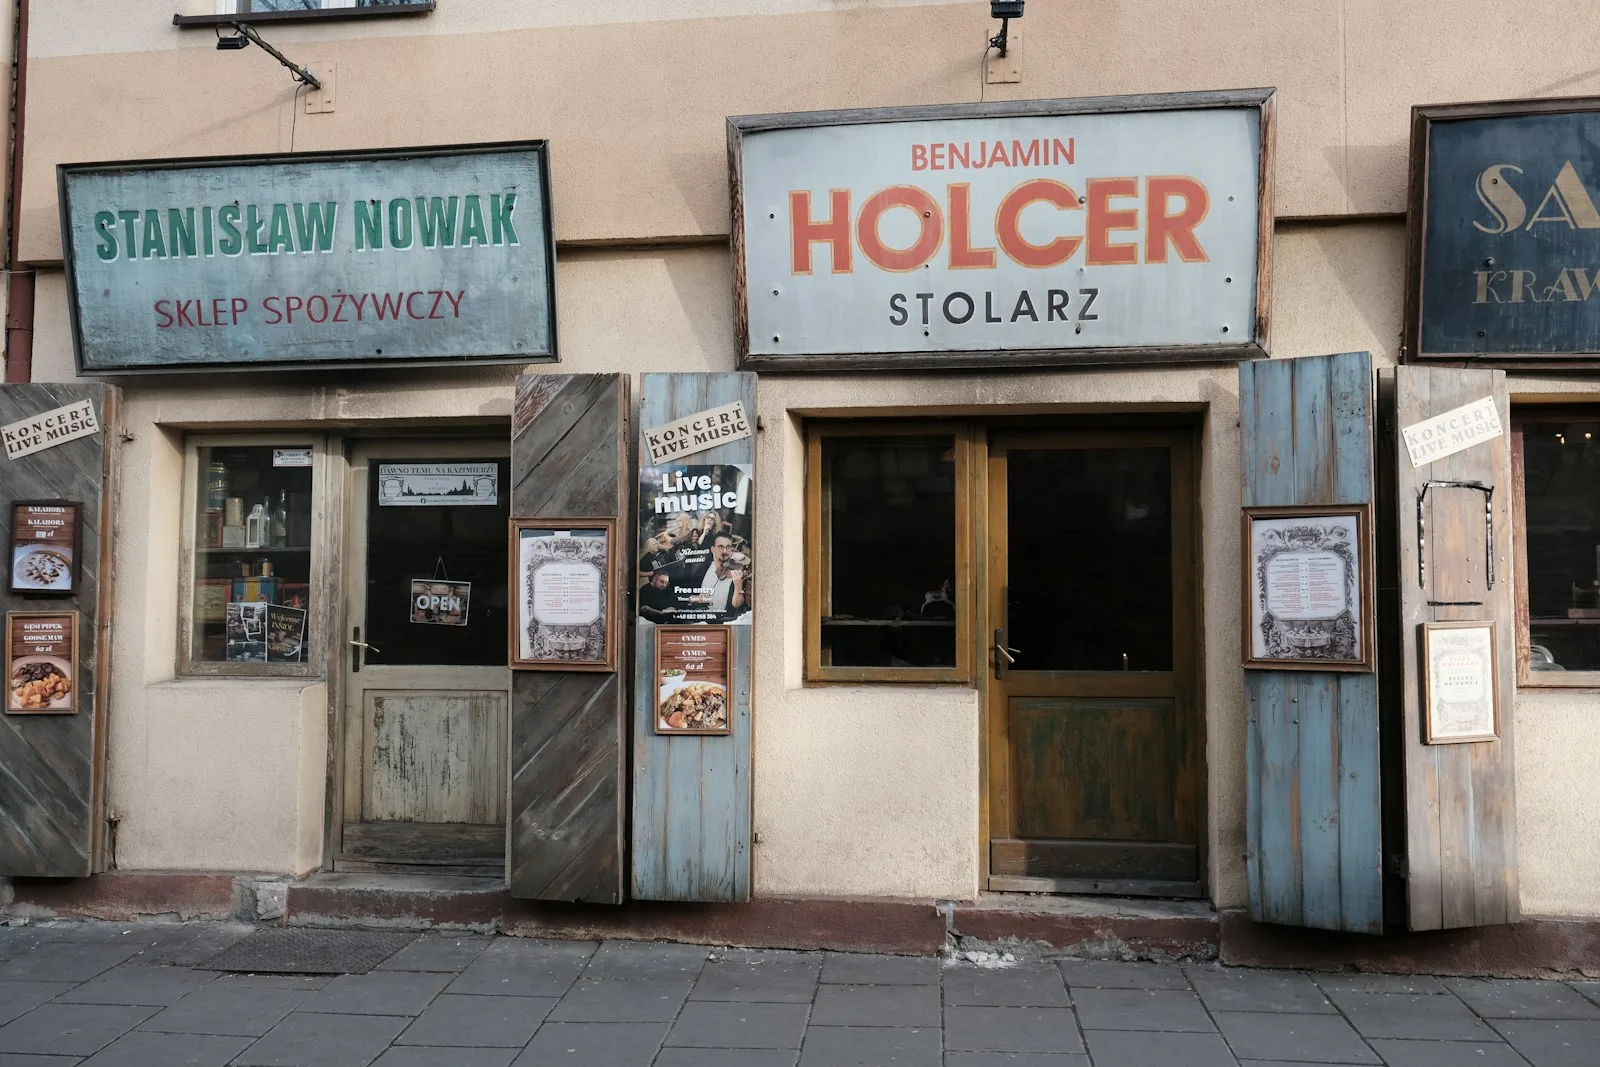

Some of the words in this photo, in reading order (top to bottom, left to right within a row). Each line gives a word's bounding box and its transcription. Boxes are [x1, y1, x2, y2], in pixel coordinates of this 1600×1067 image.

[911, 137, 1076, 171] BENJAMIN
[1473, 159, 1600, 234] SA
[94, 202, 338, 263] STANISŁAW
[354, 193, 521, 253] NOWAK
[788, 174, 1212, 277] HOLCER
[154, 297, 248, 328] SKLEP
[263, 289, 465, 325] SPOŻYWCZY
[889, 288, 1099, 327] STOLARZ
[4, 406, 91, 442] KONCERT
[8, 434, 42, 454] LIVE
[47, 417, 95, 442] MUSIC
[648, 408, 742, 447] KONCERT
[652, 438, 689, 459] LIVE
[694, 420, 747, 446] MUSIC
[1407, 405, 1494, 447] KONCERT
[1411, 438, 1447, 460] LIVE
[1451, 418, 1500, 446] MUSIC
[380, 466, 410, 474] DAWNO
[411, 466, 432, 474] TEMU
[435, 466, 446, 474] NA
[446, 466, 497, 474] KAZIMIERZU
[662, 470, 712, 493] Live
[654, 485, 737, 514] music
[685, 556, 706, 564] music
[416, 595, 460, 611] OPEN
[692, 587, 714, 596] entry
[270, 612, 300, 624] Welcome
